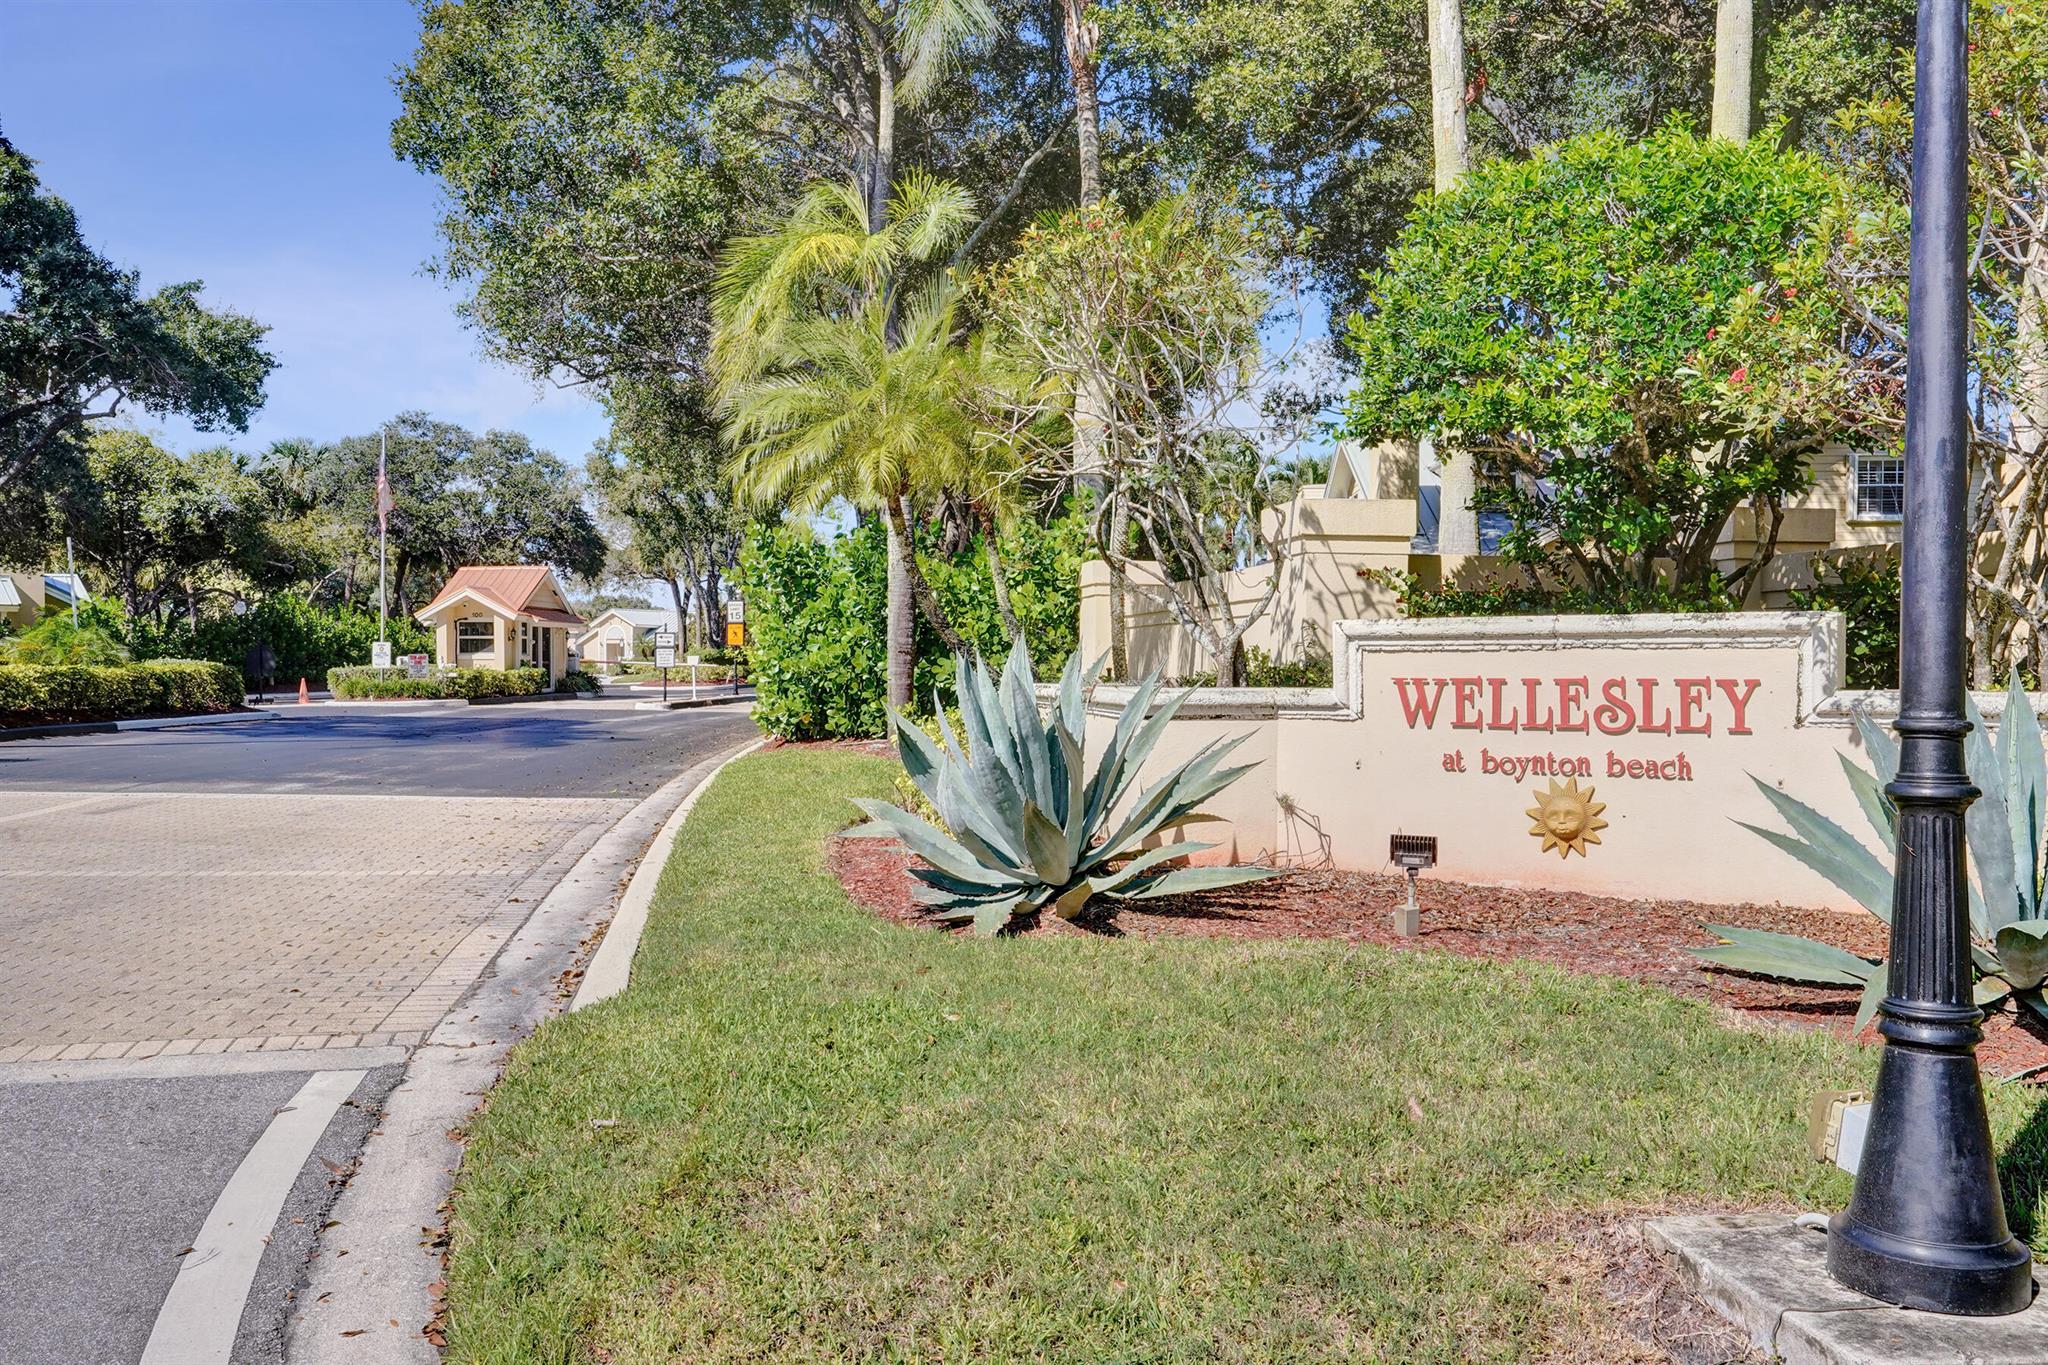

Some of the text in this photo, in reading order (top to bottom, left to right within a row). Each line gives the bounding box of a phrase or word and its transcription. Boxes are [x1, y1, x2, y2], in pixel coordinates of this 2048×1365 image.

[730, 612, 741, 620] 15
[1391, 676, 1761, 738] WELLESLEY
[1442, 748, 1693, 783] at boynton beach
